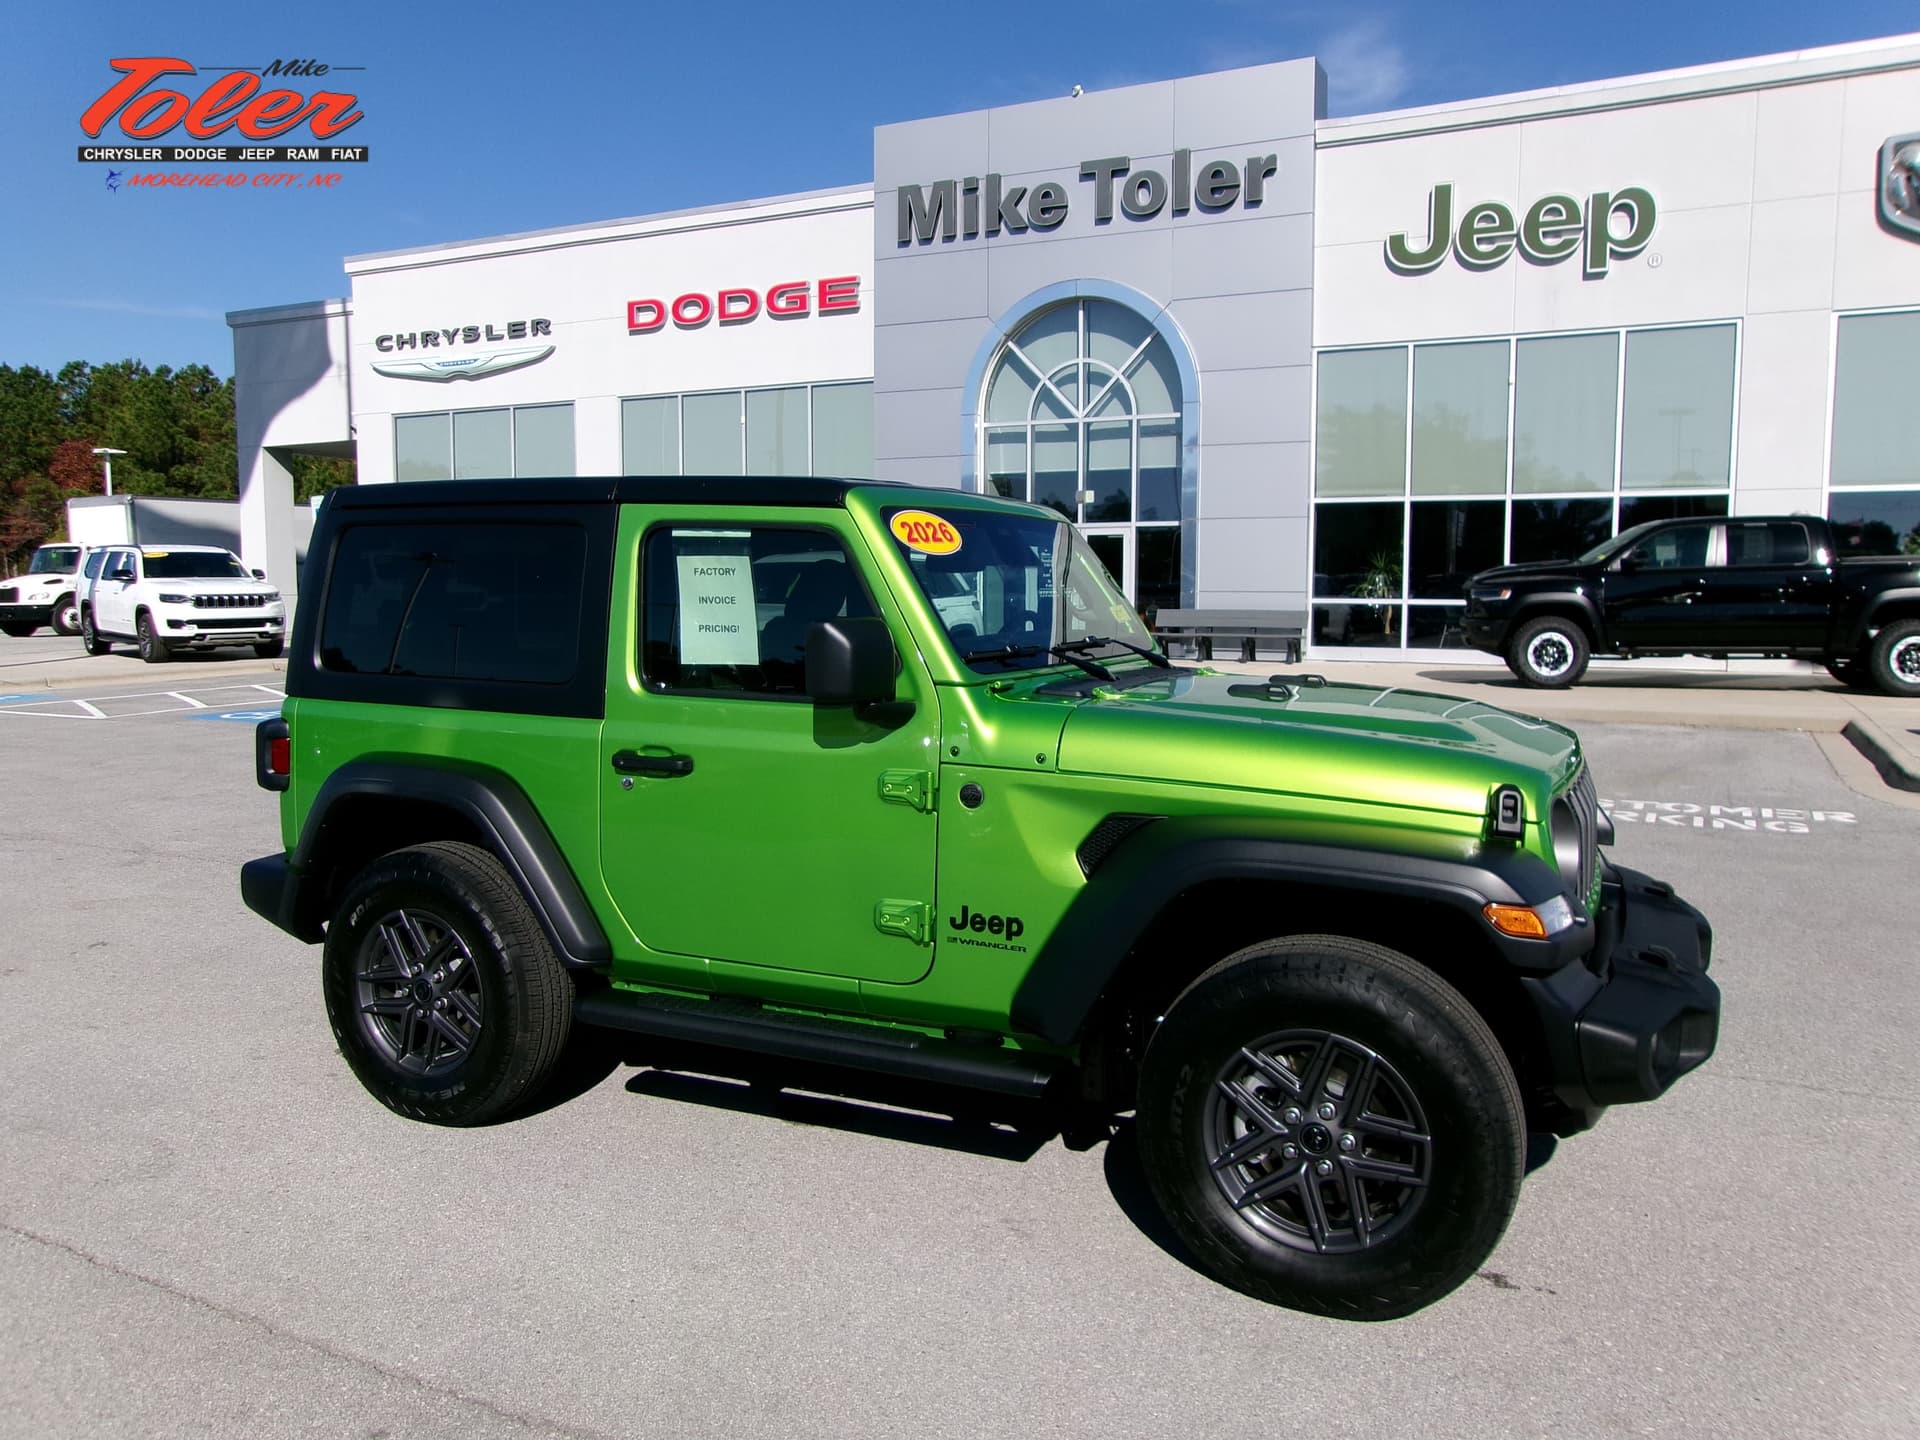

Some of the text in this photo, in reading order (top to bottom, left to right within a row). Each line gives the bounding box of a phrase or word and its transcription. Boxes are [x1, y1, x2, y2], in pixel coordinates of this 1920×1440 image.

[897, 148, 1278, 248] Mike Toler
[1384, 181, 1658, 281] Jeep
[626, 275, 860, 336] DODGE
[375, 318, 552, 351] CHRYSLER
[900, 521, 954, 543] 2026
[693, 567, 736, 577] FACTORY
[698, 596, 737, 605] INVOICE
[698, 624, 740, 634] PRICING!
[949, 905, 1024, 941] Jeep
[959, 938, 1027, 953] WRANGLER
